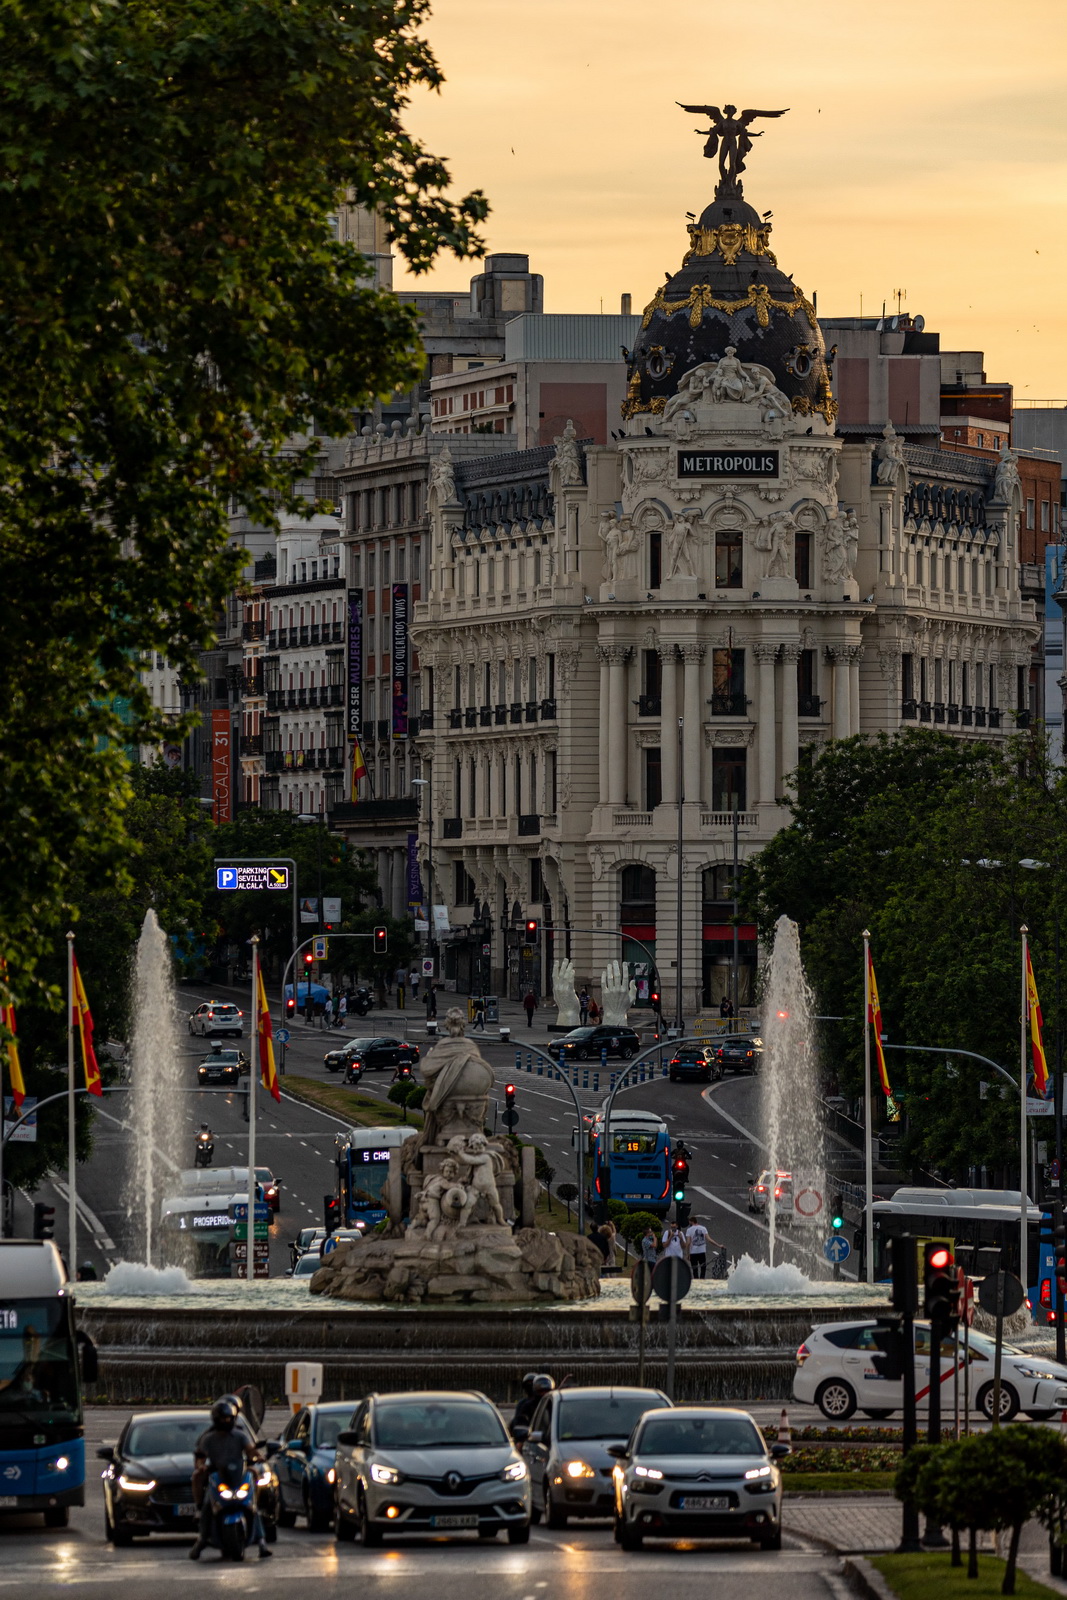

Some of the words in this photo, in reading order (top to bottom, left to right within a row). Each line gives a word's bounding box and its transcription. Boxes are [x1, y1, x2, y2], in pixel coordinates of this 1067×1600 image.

[683, 457, 774, 471] METROPOLIS
[395, 598, 406, 619] VIVAS
[395, 620, 406, 660] QUEREMOS
[350, 626, 360, 684] MUJERES
[395, 661, 406, 677] NOS
[350, 686, 360, 706] SER
[350, 708, 360, 732] POR
[215, 731, 228, 746] 31
[223, 871, 233, 886] P
[627, 1142, 639, 1151] 15
[363, 1152, 370, 1162] 5
[180, 1218, 187, 1229] 1
